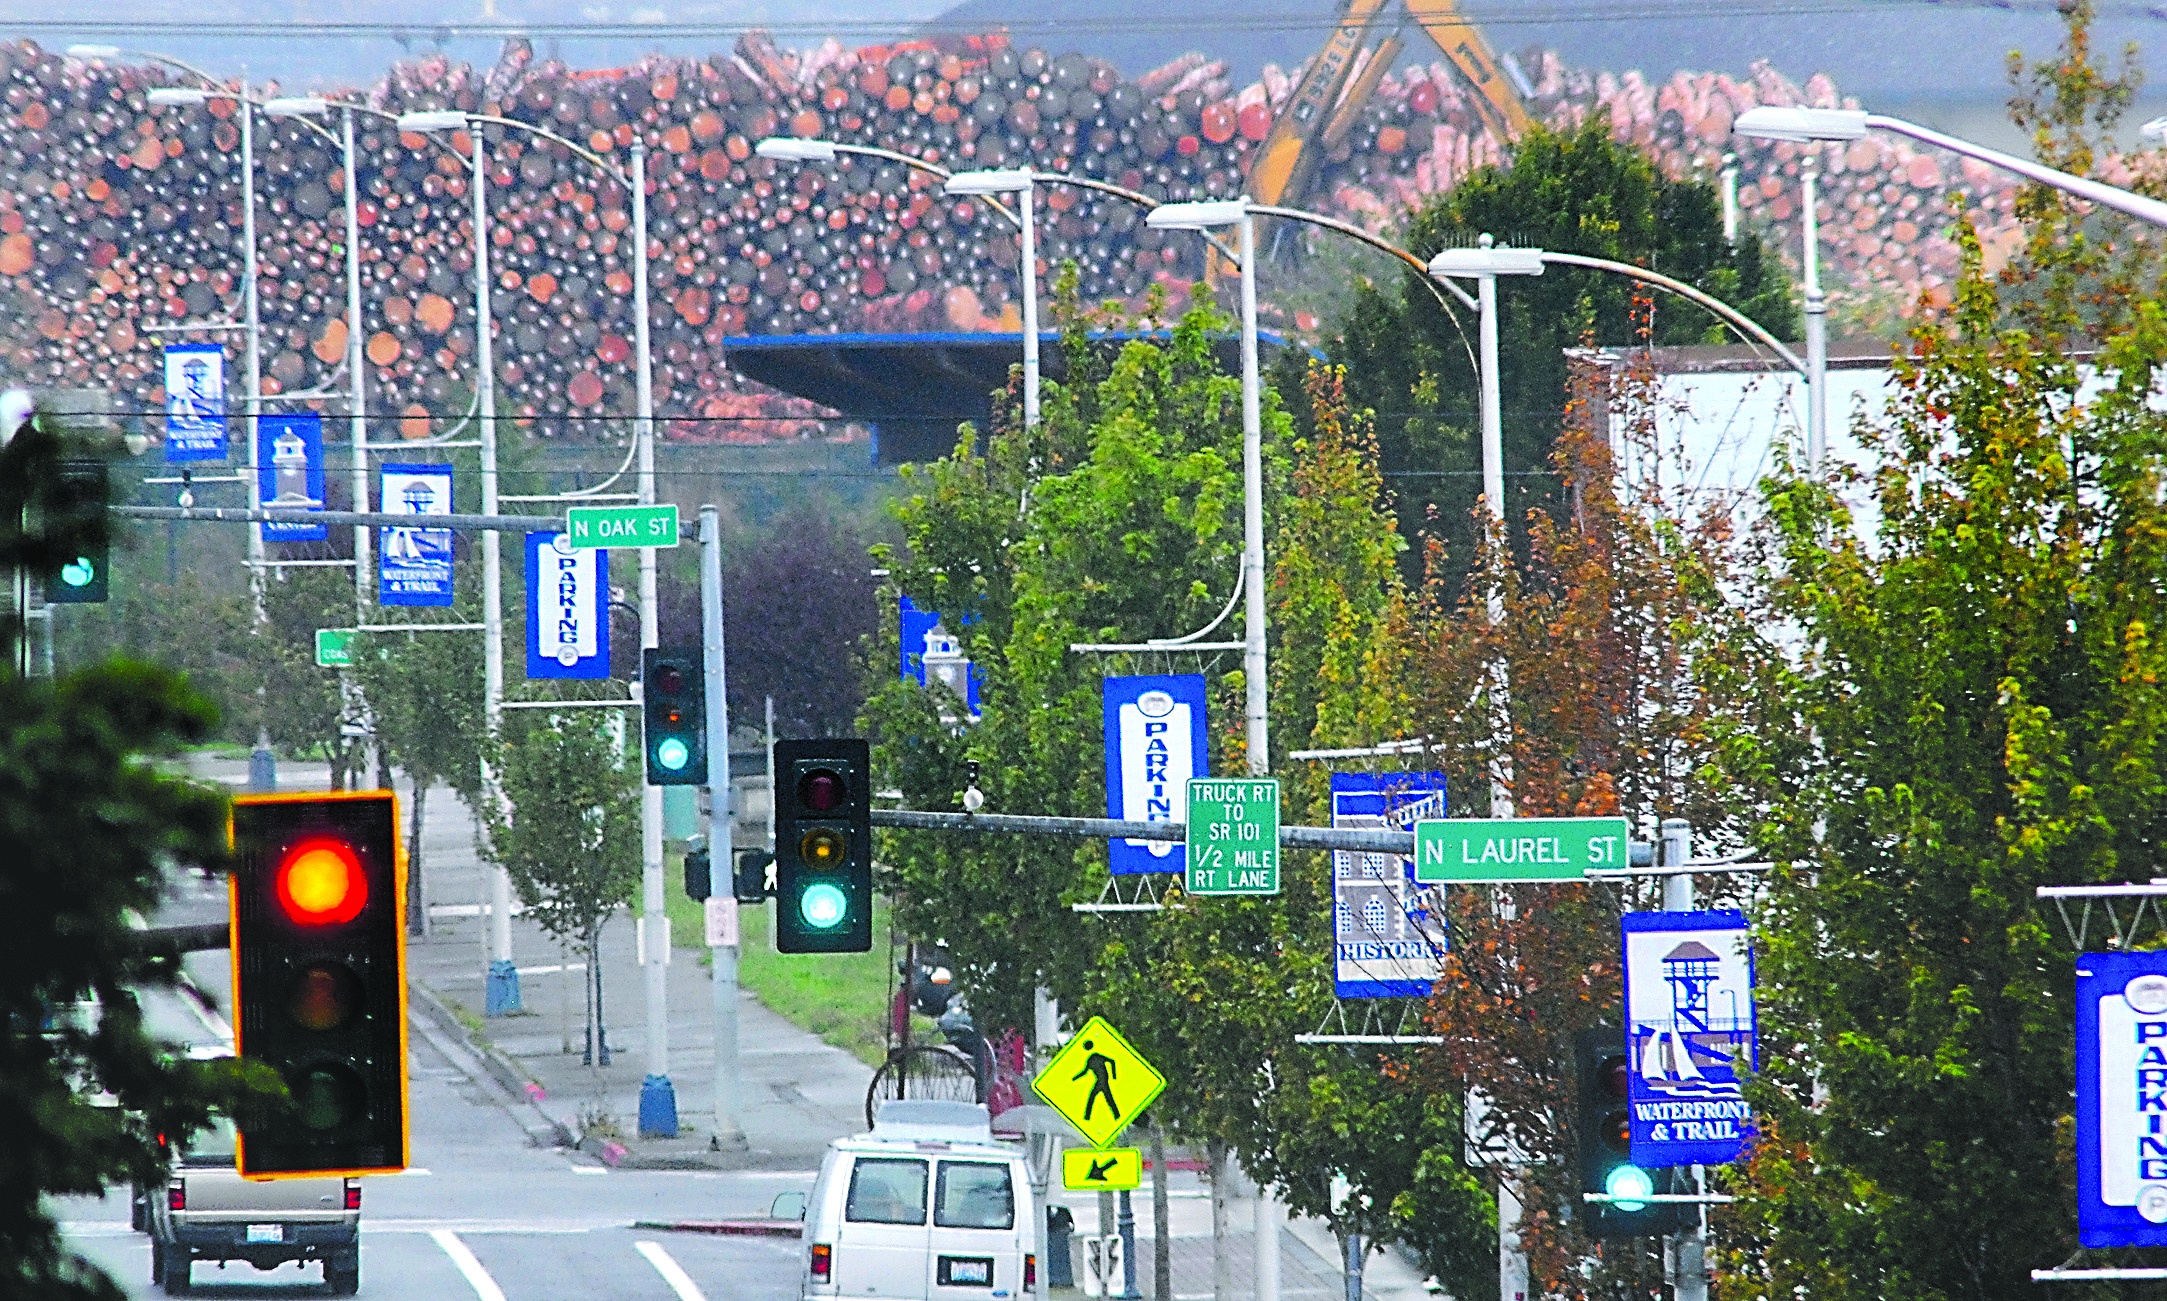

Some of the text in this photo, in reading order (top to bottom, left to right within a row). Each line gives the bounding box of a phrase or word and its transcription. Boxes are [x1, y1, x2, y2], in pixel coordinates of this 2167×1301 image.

[575, 517, 670, 537] N OAK ST
[558, 558, 578, 644] PARKING
[1193, 785, 1273, 802] TRUCK RT
[1223, 804, 1244, 821] TO
[1209, 823, 1260, 841] SR 101
[1195, 844, 1272, 868] 1/2 MILE
[1426, 836, 1618, 864] N LAUREL ST
[1195, 870, 1269, 888] RT LANE
[1635, 1100, 1751, 1121] WATERFRONT
[1651, 1120, 1740, 1141] & TRAIL
